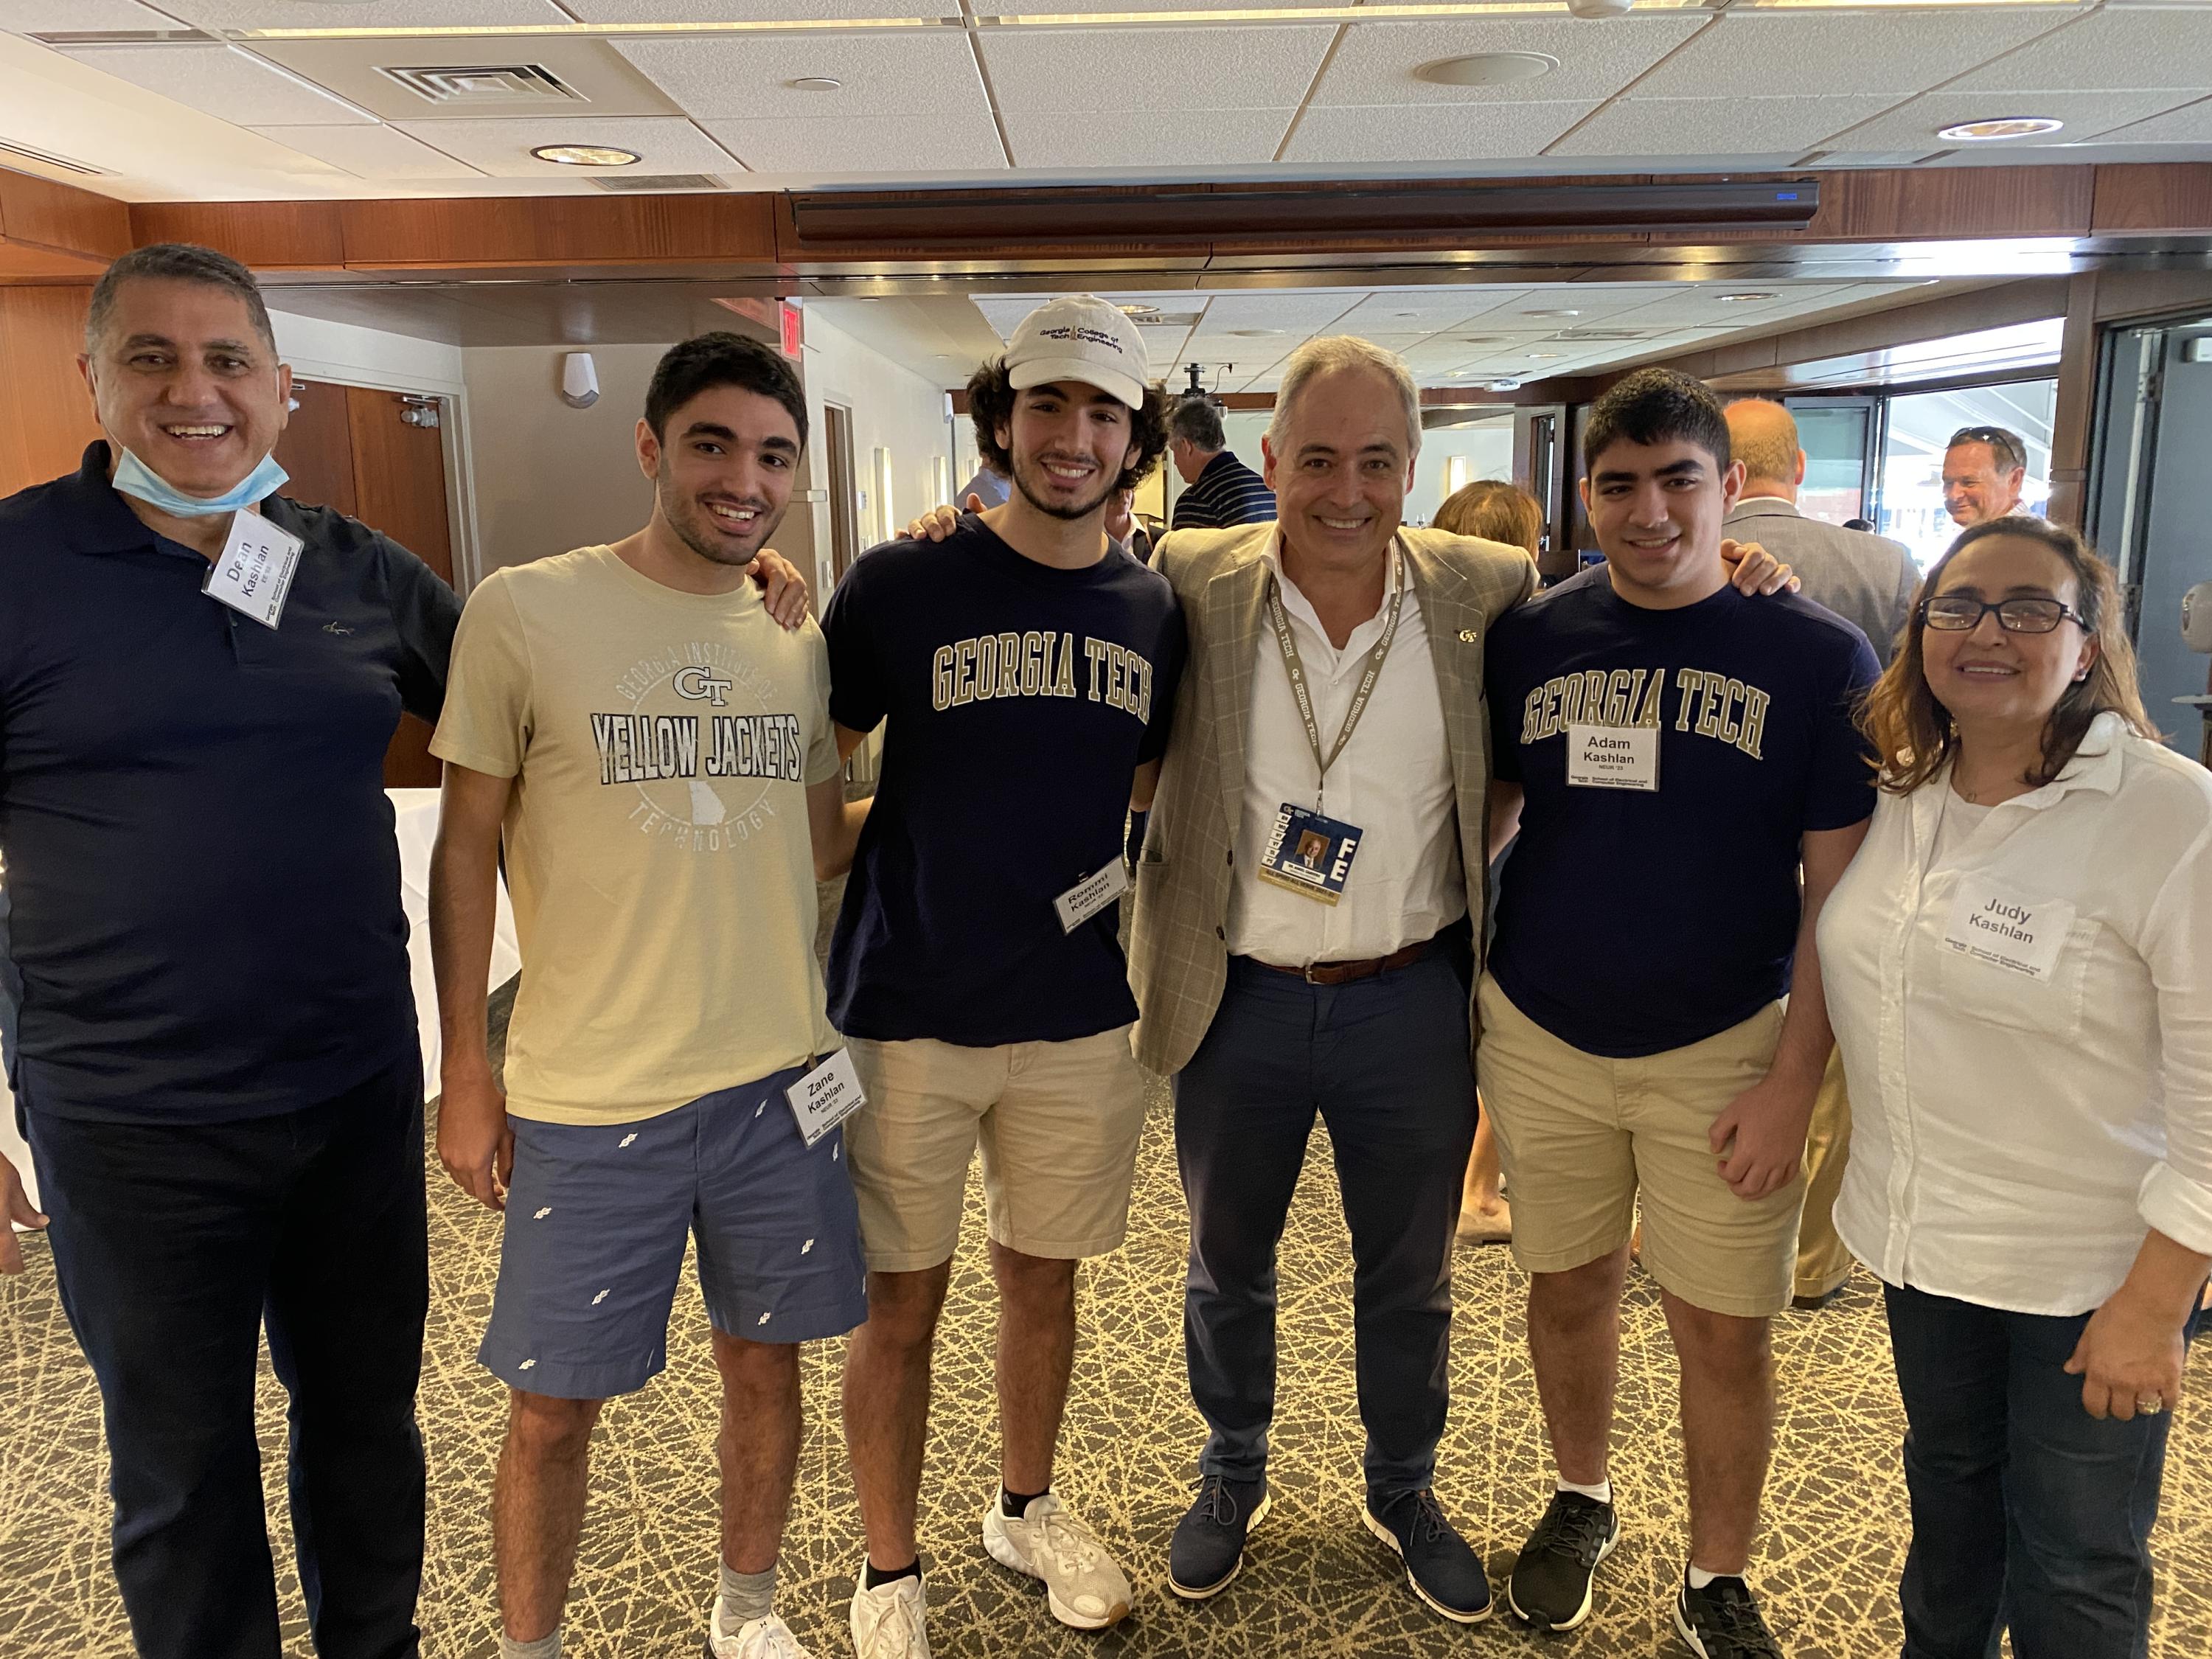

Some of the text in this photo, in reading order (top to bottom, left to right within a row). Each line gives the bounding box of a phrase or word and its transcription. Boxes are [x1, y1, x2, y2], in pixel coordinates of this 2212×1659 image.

[1040, 326, 1071, 336] Georgia
[1077, 327, 1109, 339] College
[1077, 333, 1122, 354] Engineering
[226, 542, 252, 582] Dean
[242, 546, 269, 597] Kashlan
[1271, 597, 1294, 659] GEORGIA TECH
[1381, 612, 1397, 647] GEORGIA
[616, 645, 681, 700] GEORGIA
[672, 667, 733, 706] GT
[933, 631, 1153, 726] GEORGIA TECH
[1295, 683, 1318, 748] GEORGIA TECH
[1345, 670, 1375, 732] GEORGIA TECH
[1520, 668, 1770, 759] GEORGIA TECH
[590, 713, 801, 785] YELLOW JACKETS
[1584, 752, 1634, 764] Kashlan
[1587, 736, 1630, 750] Adam
[628, 799, 776, 852] TECHNOLOGY
[1071, 883, 1110, 912] Kashlan
[1984, 898, 2032, 925] Judy
[1969, 914, 2034, 944] Kashlan
[807, 1072, 834, 1097] Zane
[807, 1082, 845, 1114] Kashlan
